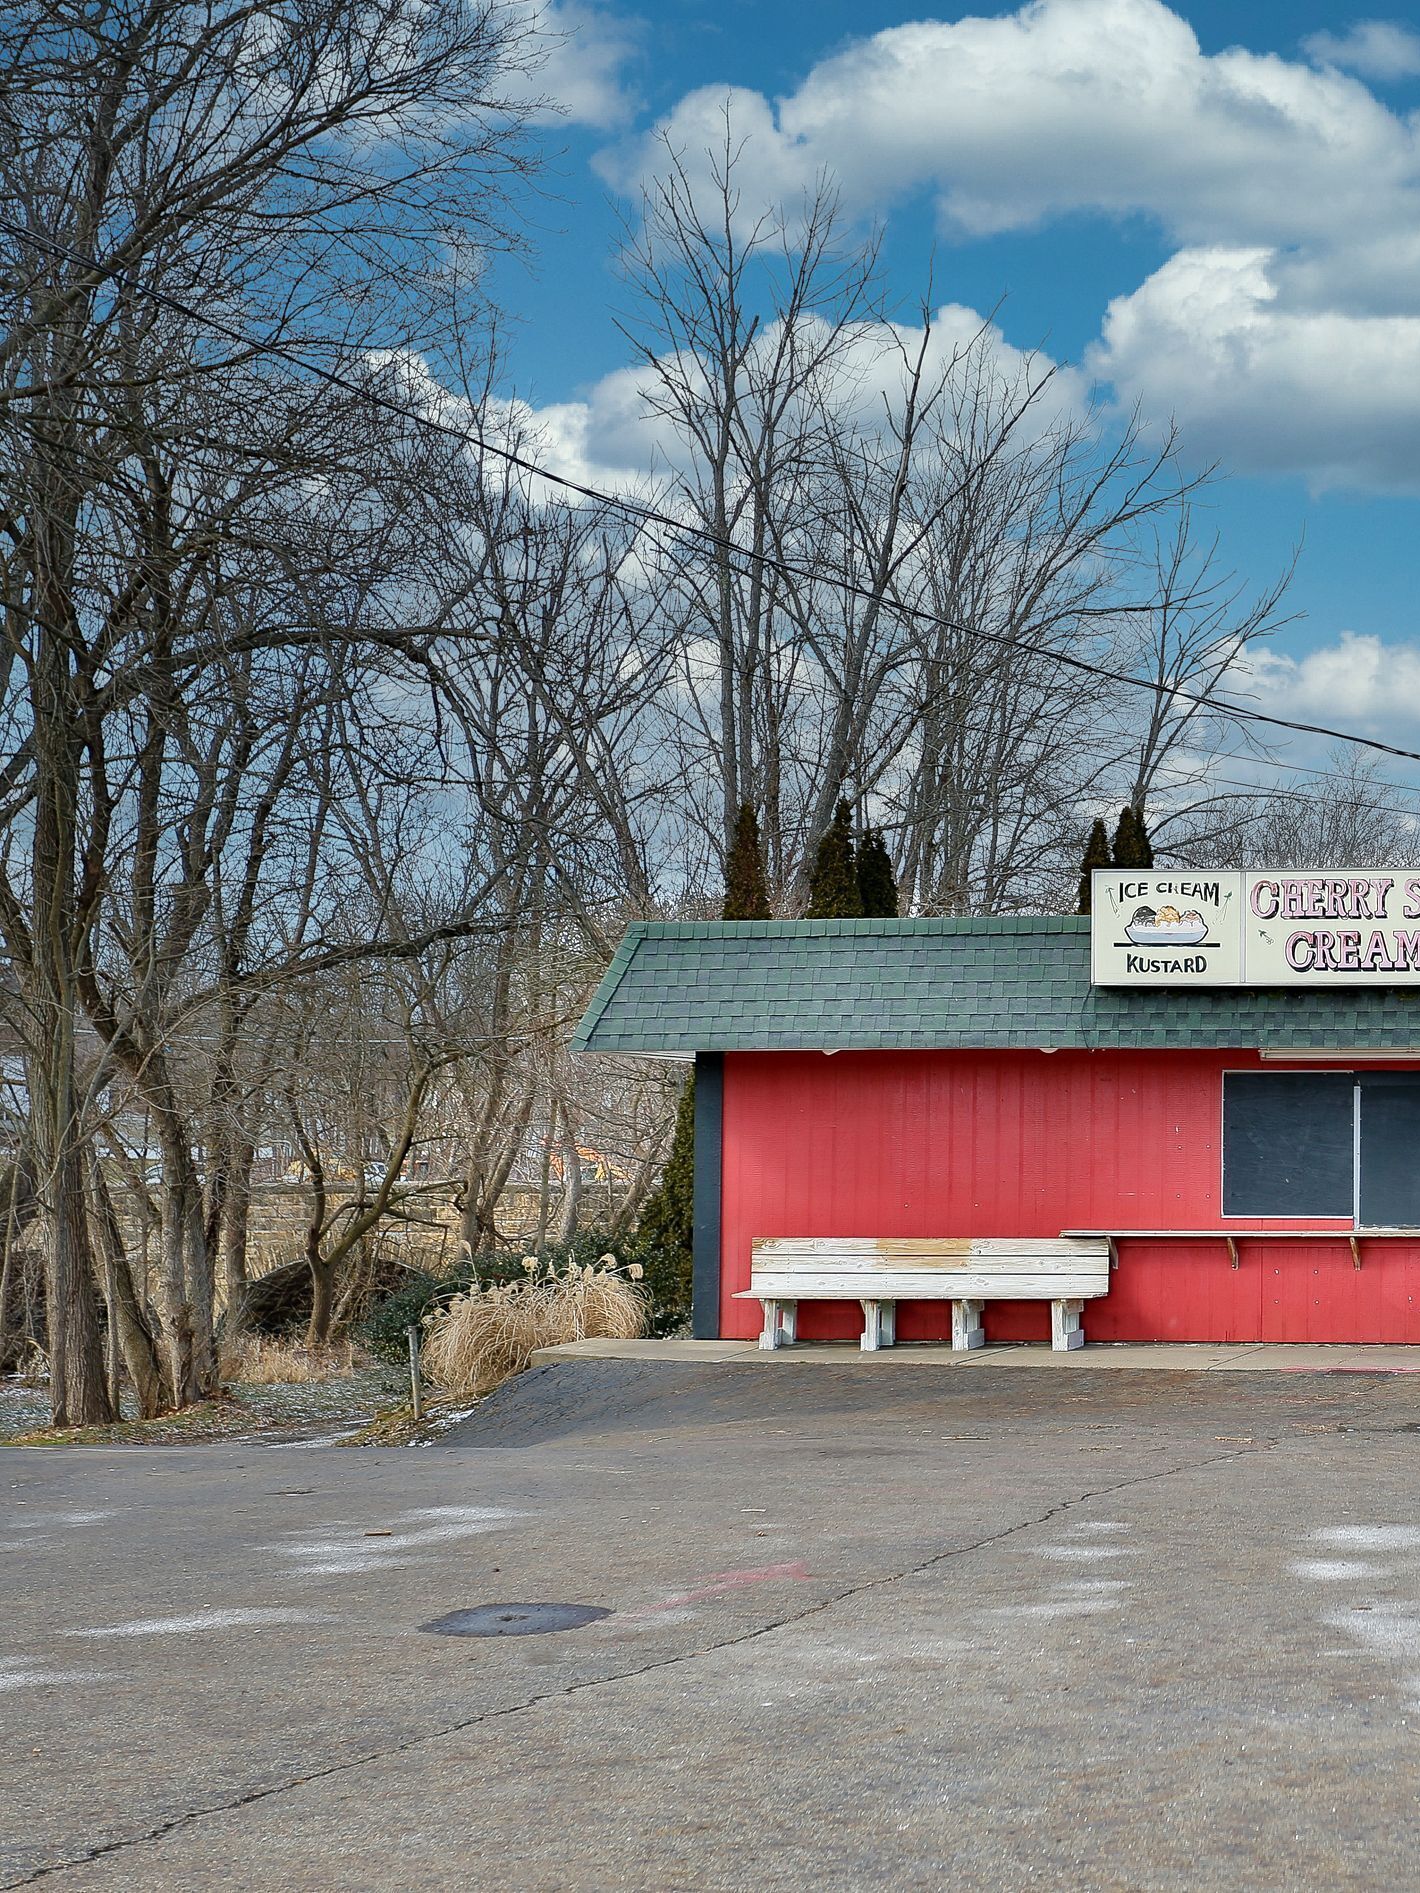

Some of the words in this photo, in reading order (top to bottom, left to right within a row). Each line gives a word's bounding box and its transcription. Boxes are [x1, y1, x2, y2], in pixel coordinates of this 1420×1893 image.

[1119, 882, 1149, 903] ICE
[1155, 882, 1220, 907] CREAM
[1250, 878, 1393, 920] CHERRY
[1126, 953, 1208, 974] KUSTARD
